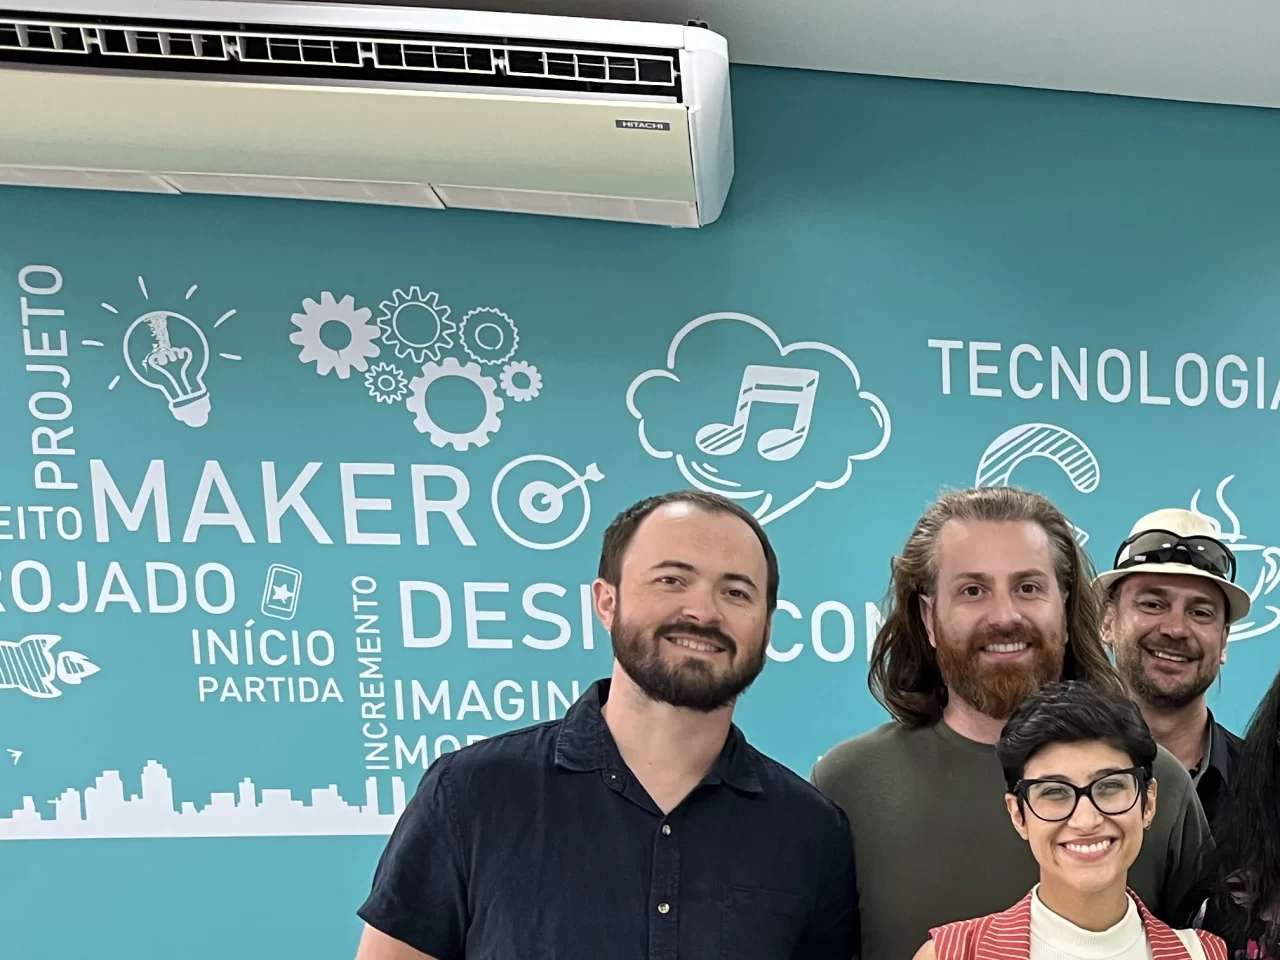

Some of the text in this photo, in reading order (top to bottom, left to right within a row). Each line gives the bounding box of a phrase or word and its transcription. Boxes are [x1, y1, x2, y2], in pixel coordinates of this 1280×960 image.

[622, 121, 663, 129] HITACHI
[18, 264, 78, 490] PROJETO
[89, 459, 478, 546] MAKER
[0, 559, 236, 614] OJADO
[399, 580, 594, 650] DESI
[192, 619, 335, 667] INÍCIO
[351, 575, 390, 770] INCREMENTO
[199, 676, 344, 703] PARTIDA
